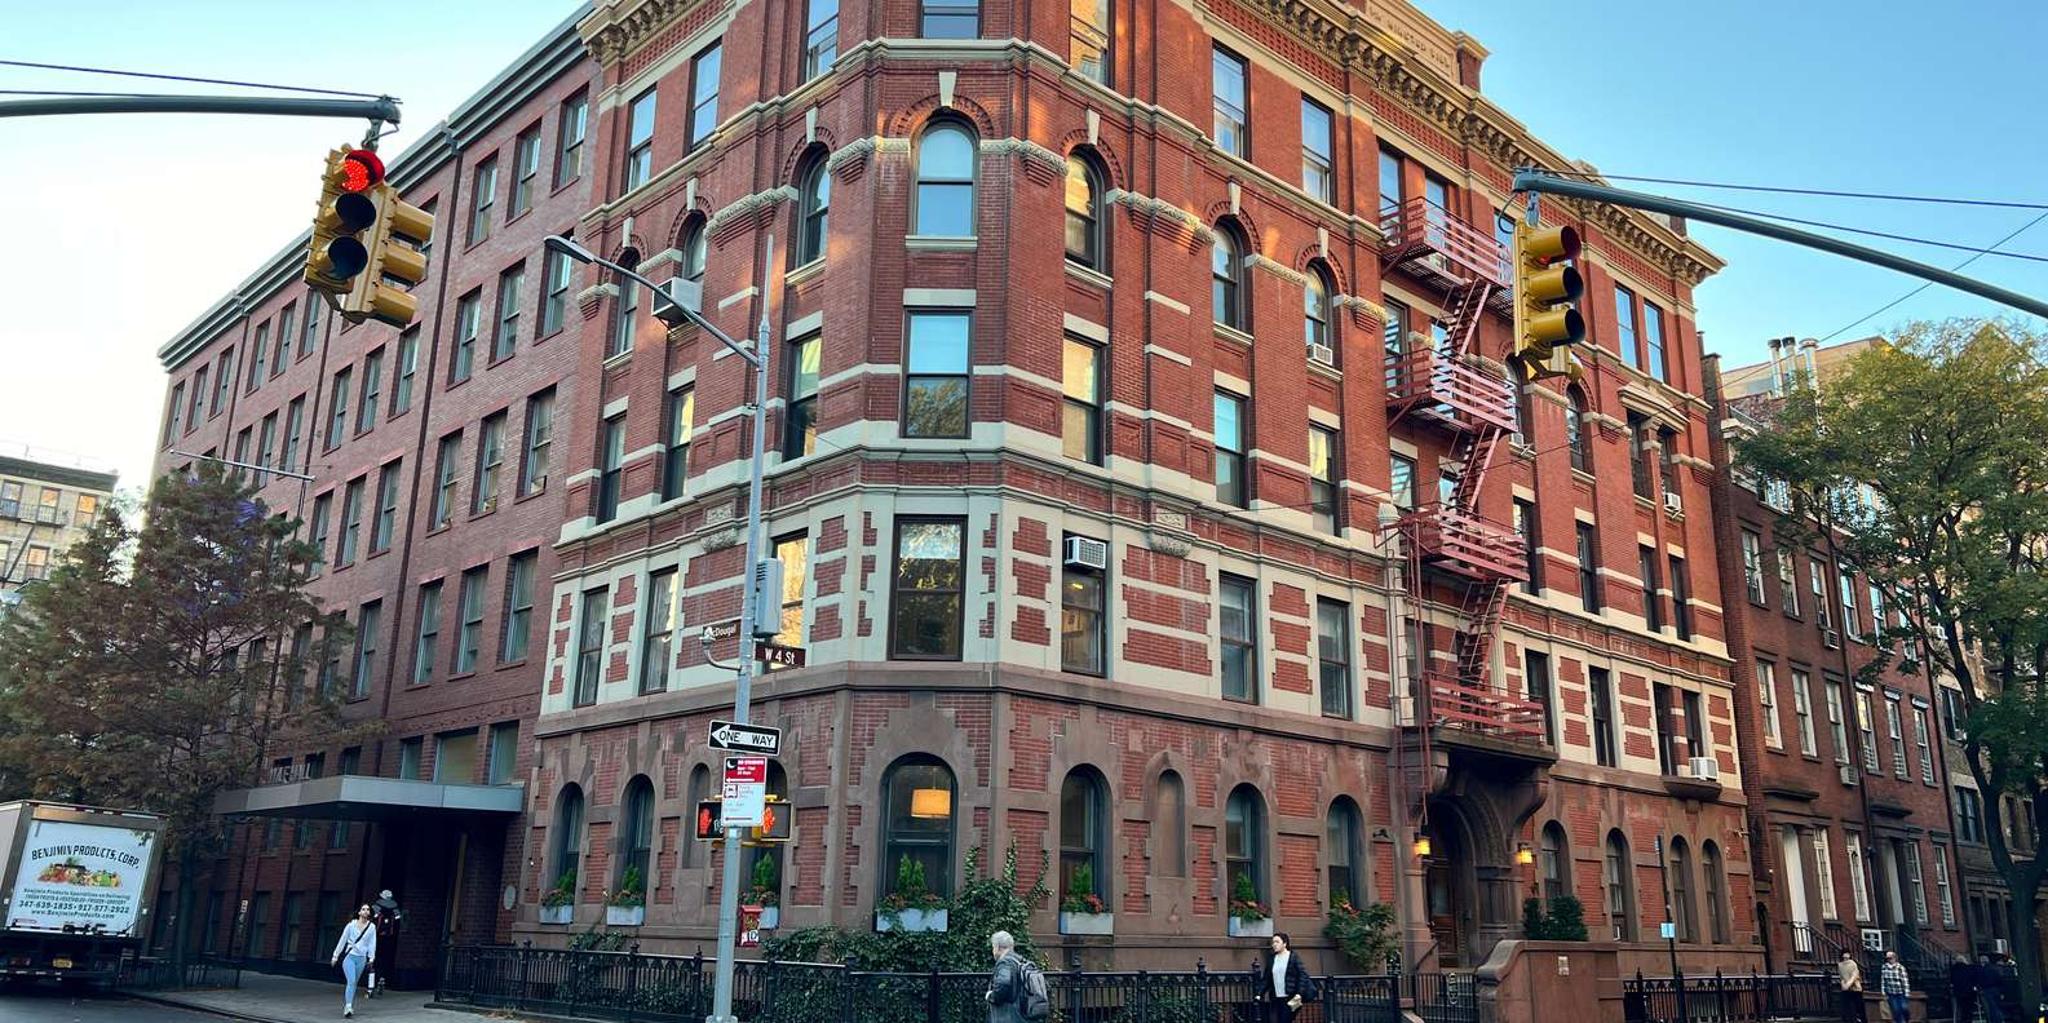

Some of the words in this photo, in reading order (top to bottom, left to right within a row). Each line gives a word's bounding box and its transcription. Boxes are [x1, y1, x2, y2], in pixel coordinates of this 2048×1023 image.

[765, 647, 773, 660] W
[775, 650, 782, 662] 4
[785, 651, 795, 664] St
[719, 731, 740, 742] ONE
[752, 734, 773, 746] WAY
[32, 845, 73, 860] BENJIMIN
[118, 852, 140, 869] CORP.
